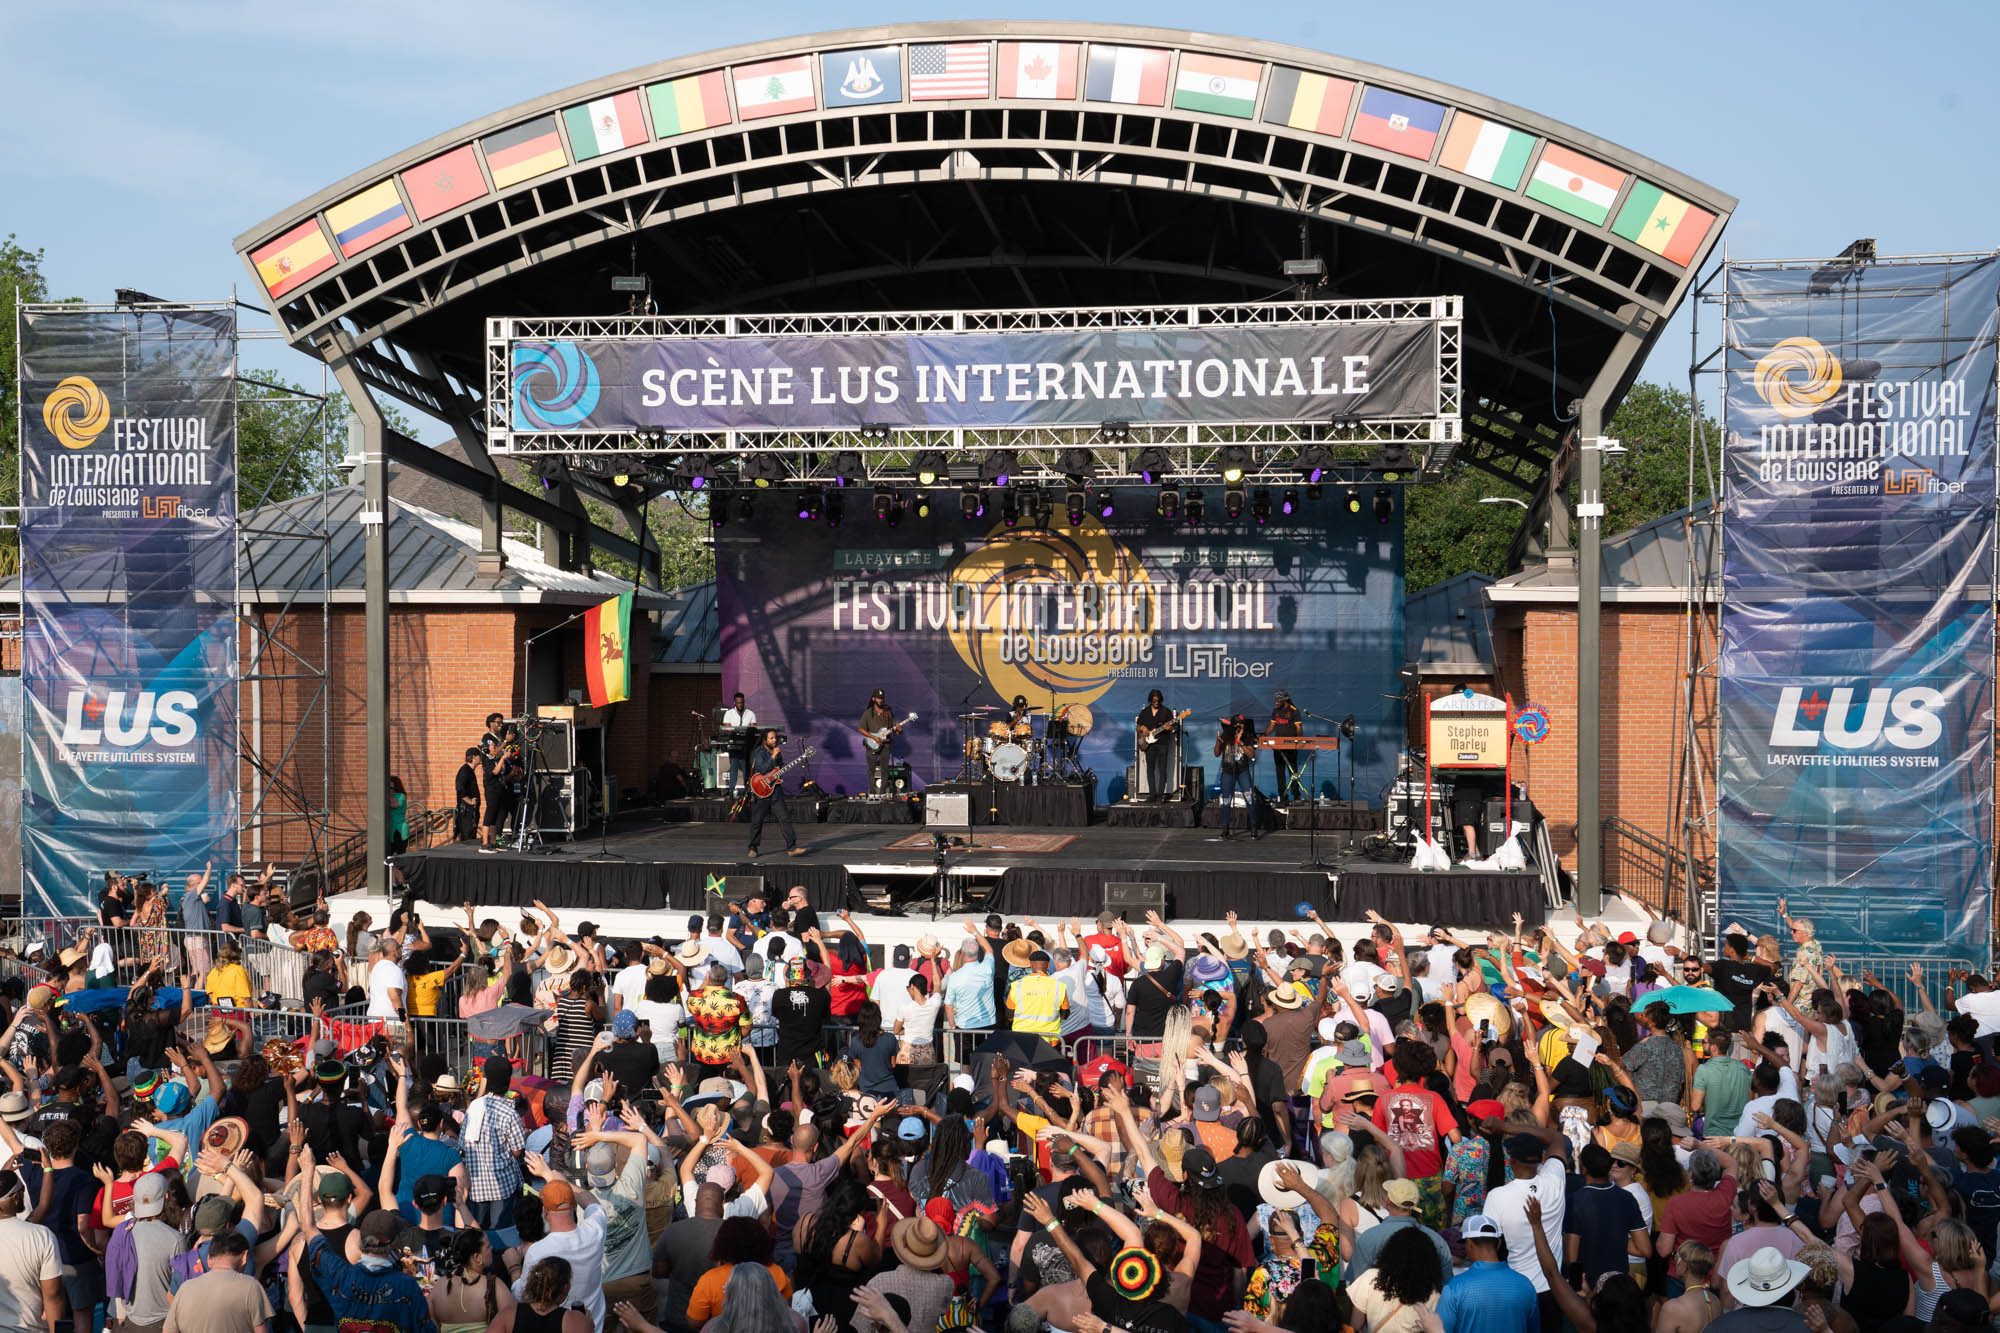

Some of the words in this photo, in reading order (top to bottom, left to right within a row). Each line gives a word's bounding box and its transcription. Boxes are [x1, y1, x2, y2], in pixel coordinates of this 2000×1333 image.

[642, 356, 794, 407] SCÈNE
[810, 365, 900, 405] LUS
[915, 355, 1370, 404] INTERNATIONALE
[1847, 379, 1971, 419] FESTIVAL
[113, 417, 211, 451] FESTIVAL
[1761, 418, 1970, 460] INTERNATIONAL
[50, 452, 212, 486] INTERNATIONAL
[1760, 455, 1782, 483] de
[1786, 456, 1880, 482] Louisiane
[49, 483, 66, 507] de
[67, 483, 139, 507] Louisiane
[1831, 485, 1868, 495] PRESENTED
[1869, 485, 1879, 495] BY
[102, 510, 130, 518] PRESENTED
[131, 510, 139, 518] BY
[844, 553, 932, 565] LAFAYETTE
[1171, 551, 1261, 564] LOUISIANA
[833, 580, 992, 632] FESTIVAL
[999, 579, 1274, 631] INTERNATIONAL
[1000, 624, 1029, 663] de
[1034, 625, 1153, 664] Louisiane
[1107, 667, 1147, 678] PRESENTED
[1148, 667, 1159, 678] BY
[1443, 699, 1496, 709] ARTISTES
[62, 690, 199, 747] LUS
[1768, 686, 1946, 750] LUS
[1447, 725, 1489, 739] Stephen
[58, 751, 109, 762] LAFAYETTE
[110, 752, 154, 763] UTILITIES
[156, 752, 196, 763] SYSTEM
[1450, 738, 1487, 752] Marley
[1767, 754, 1830, 766] LAFAYETTE
[1832, 755, 1887, 767] UTILITIES
[1890, 756, 1939, 767] SYSTEM
